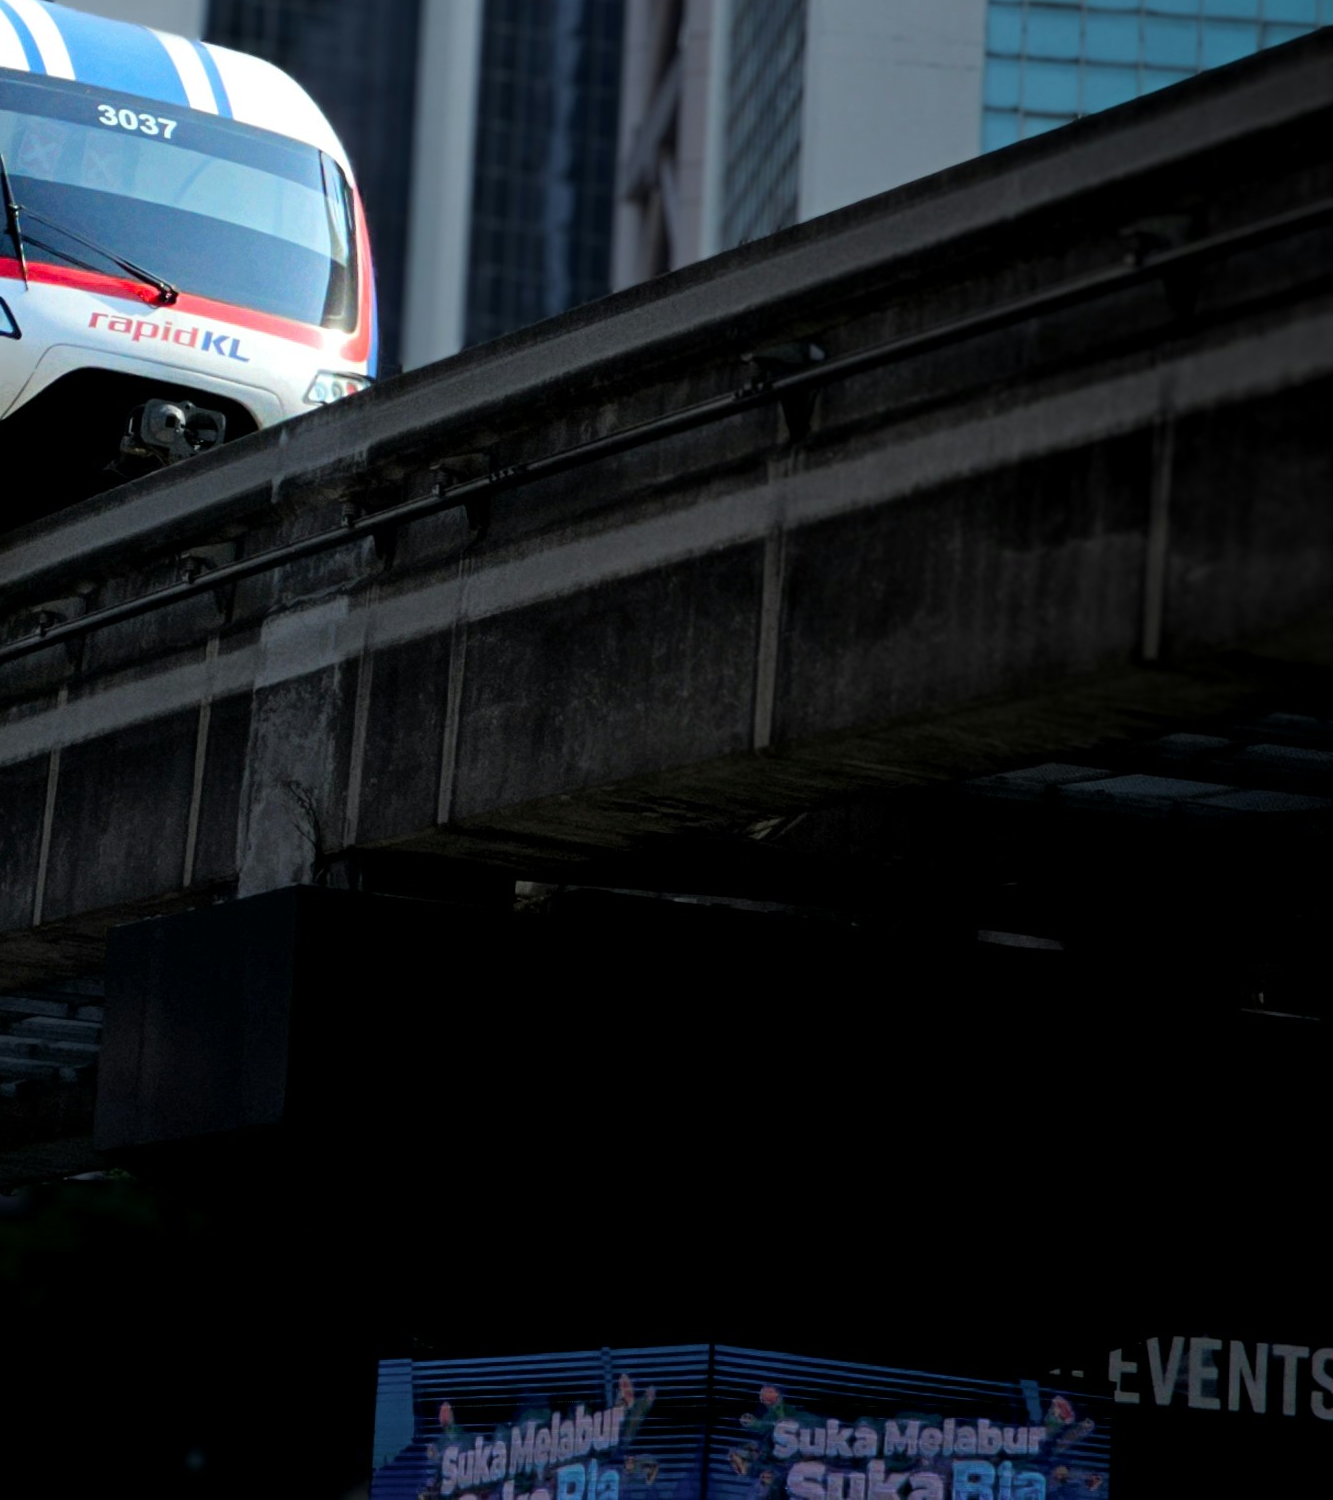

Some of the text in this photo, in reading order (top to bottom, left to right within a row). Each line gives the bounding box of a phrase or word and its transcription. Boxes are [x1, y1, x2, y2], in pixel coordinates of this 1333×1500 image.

[96, 103, 179, 140] 3037
[87, 311, 251, 364] rapidKL
[440, 1403, 625, 1495] Suka Melabur
[772, 1417, 1047, 1459] Suka Melabur
